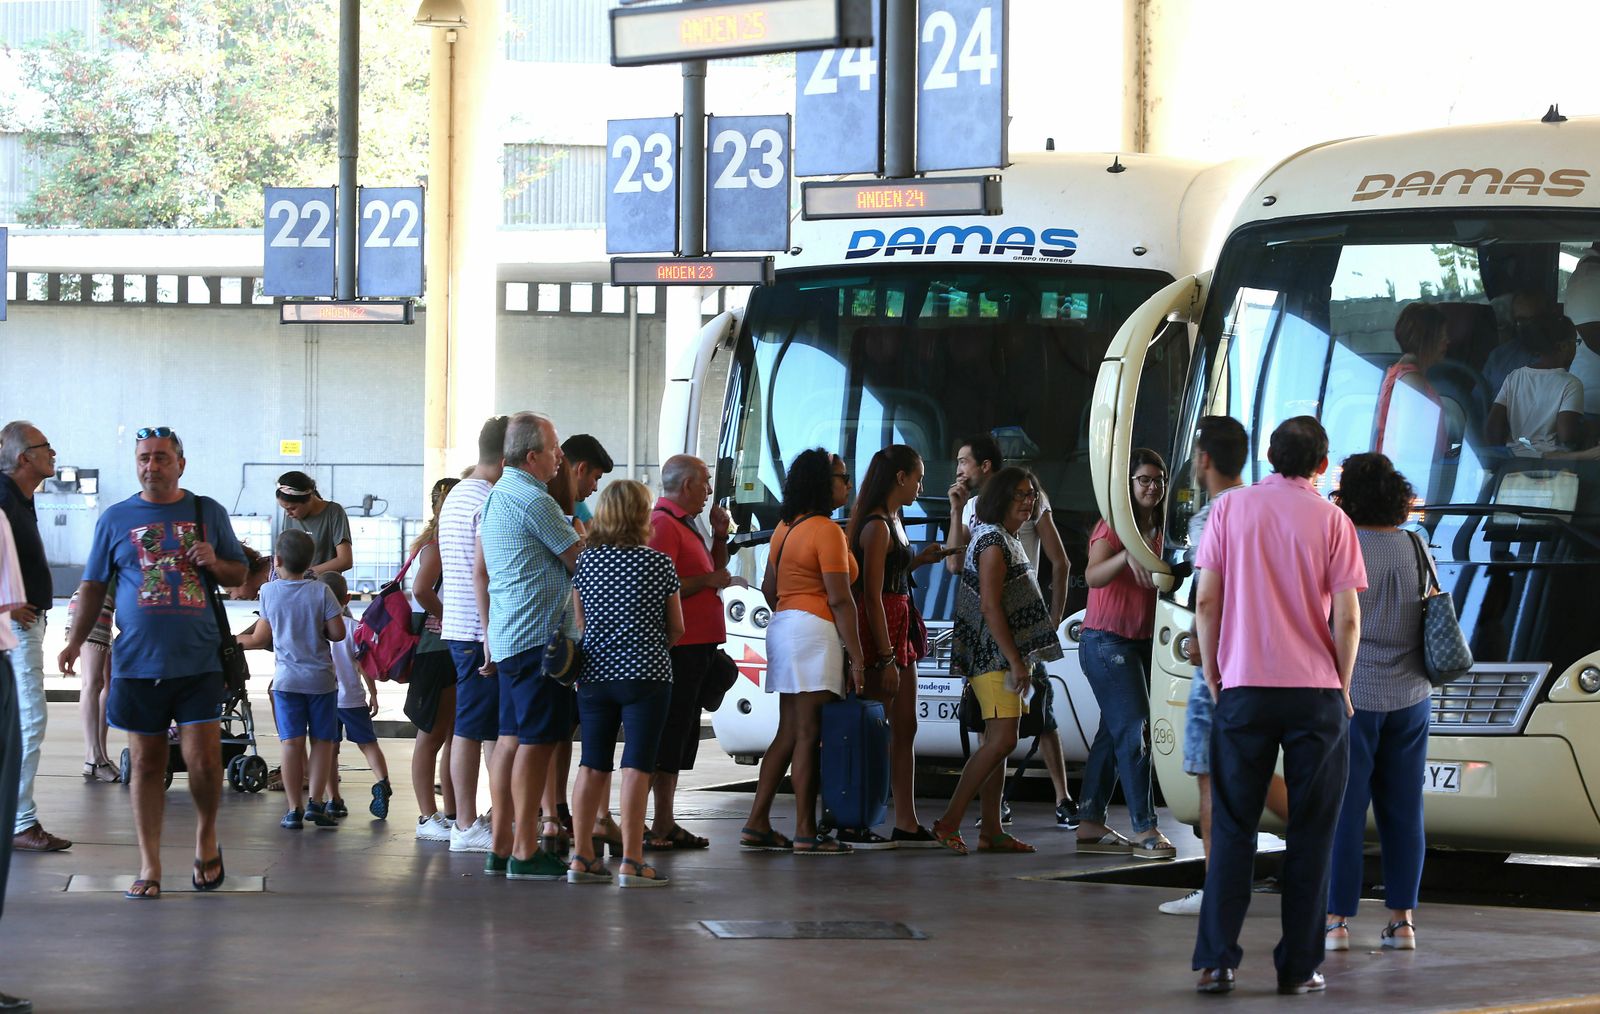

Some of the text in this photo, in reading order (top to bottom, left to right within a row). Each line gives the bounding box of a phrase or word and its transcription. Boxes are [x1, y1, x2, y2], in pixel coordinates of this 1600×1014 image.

[681, 12, 767, 43] ANDEN 25
[922, 7, 998, 91] 24
[612, 133, 674, 194] 23
[712, 128, 784, 189] 23
[857, 189, 925, 209] ANDEN 24
[1351, 168, 1591, 202] DAMAS
[269, 200, 331, 248] 22
[363, 199, 419, 248] 22
[845, 225, 1079, 260] DAMAS
[657, 265, 714, 279] ANDEN 23
[1154, 728, 1174, 744] 296
[1423, 766, 1457, 789] YZ
